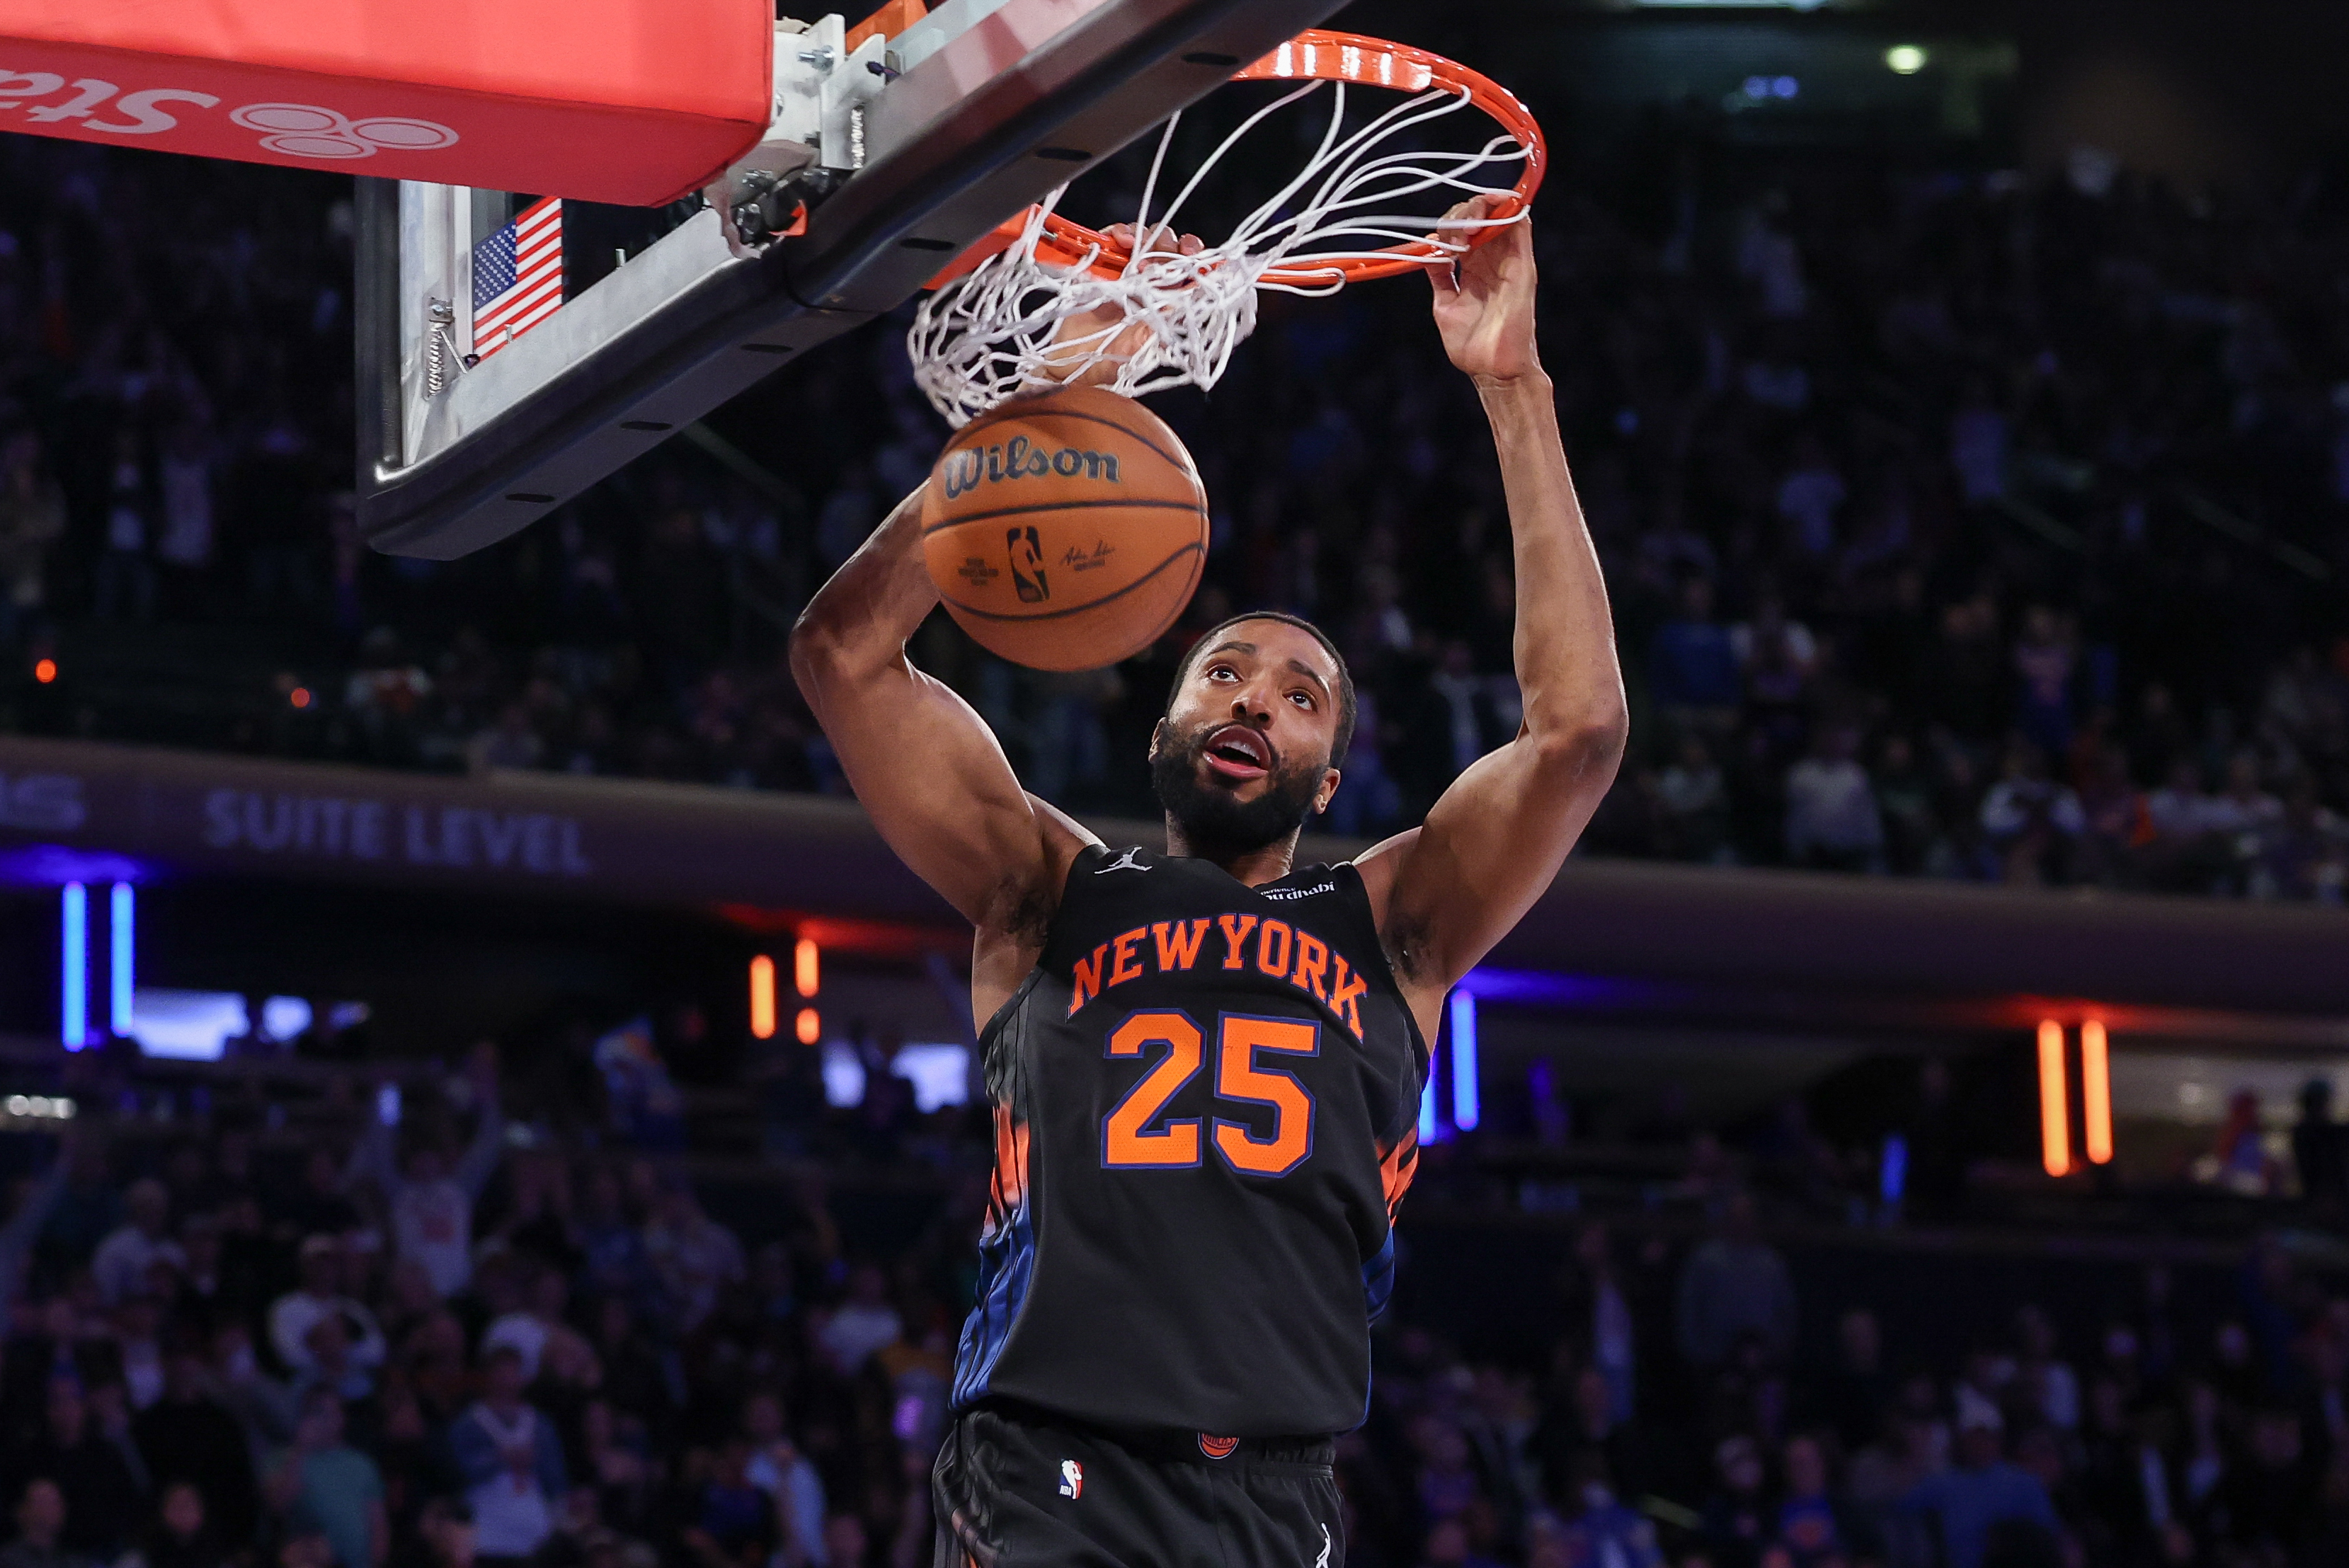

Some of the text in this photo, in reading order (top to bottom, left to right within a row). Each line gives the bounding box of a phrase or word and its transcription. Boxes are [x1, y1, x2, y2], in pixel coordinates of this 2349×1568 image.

[944, 435, 1121, 500] Wilson
[204, 787, 591, 878] SUITE LEVEL
[1286, 881, 1335, 900] dhabi
[1067, 912, 1368, 1044] NEW YORK
[1101, 1007, 1322, 1179] 25
